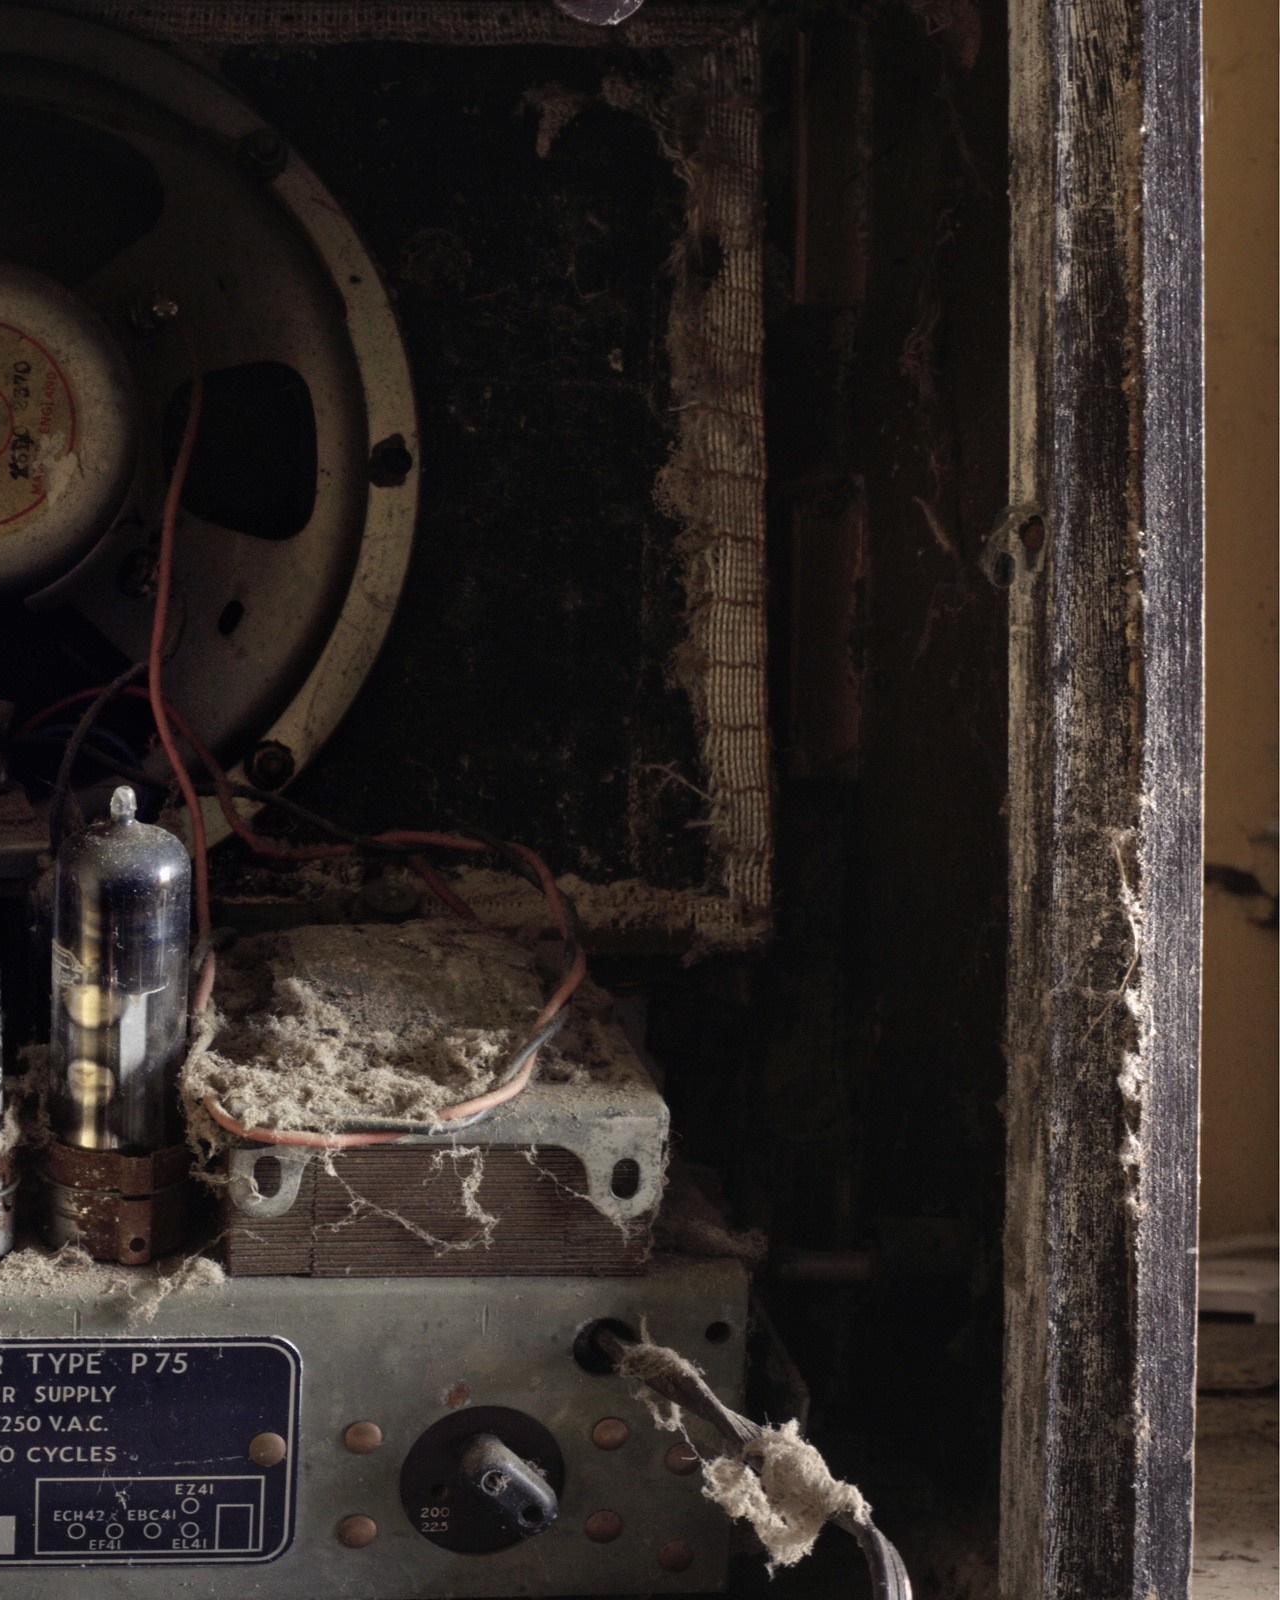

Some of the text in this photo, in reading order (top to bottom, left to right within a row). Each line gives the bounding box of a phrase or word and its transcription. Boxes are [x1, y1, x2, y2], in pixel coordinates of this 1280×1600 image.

[38, 371, 58, 435] ENGLAND
[26, 1353, 102, 1375] TYPE
[34, 1385, 117, 1403] SUPPLY
[48, 1415, 109, 1432] V.A.C.
[26, 1446, 117, 1463] CYCLES
[174, 1483, 214, 1496] EZ41
[53, 1510, 105, 1522] ECH42
[127, 1509, 176, 1521] EBC41
[420, 1506, 450, 1518] 200
[421, 1521, 449, 1533] 225
[89, 1539, 121, 1551] EF41
[172, 1538, 208, 1550] EL41
